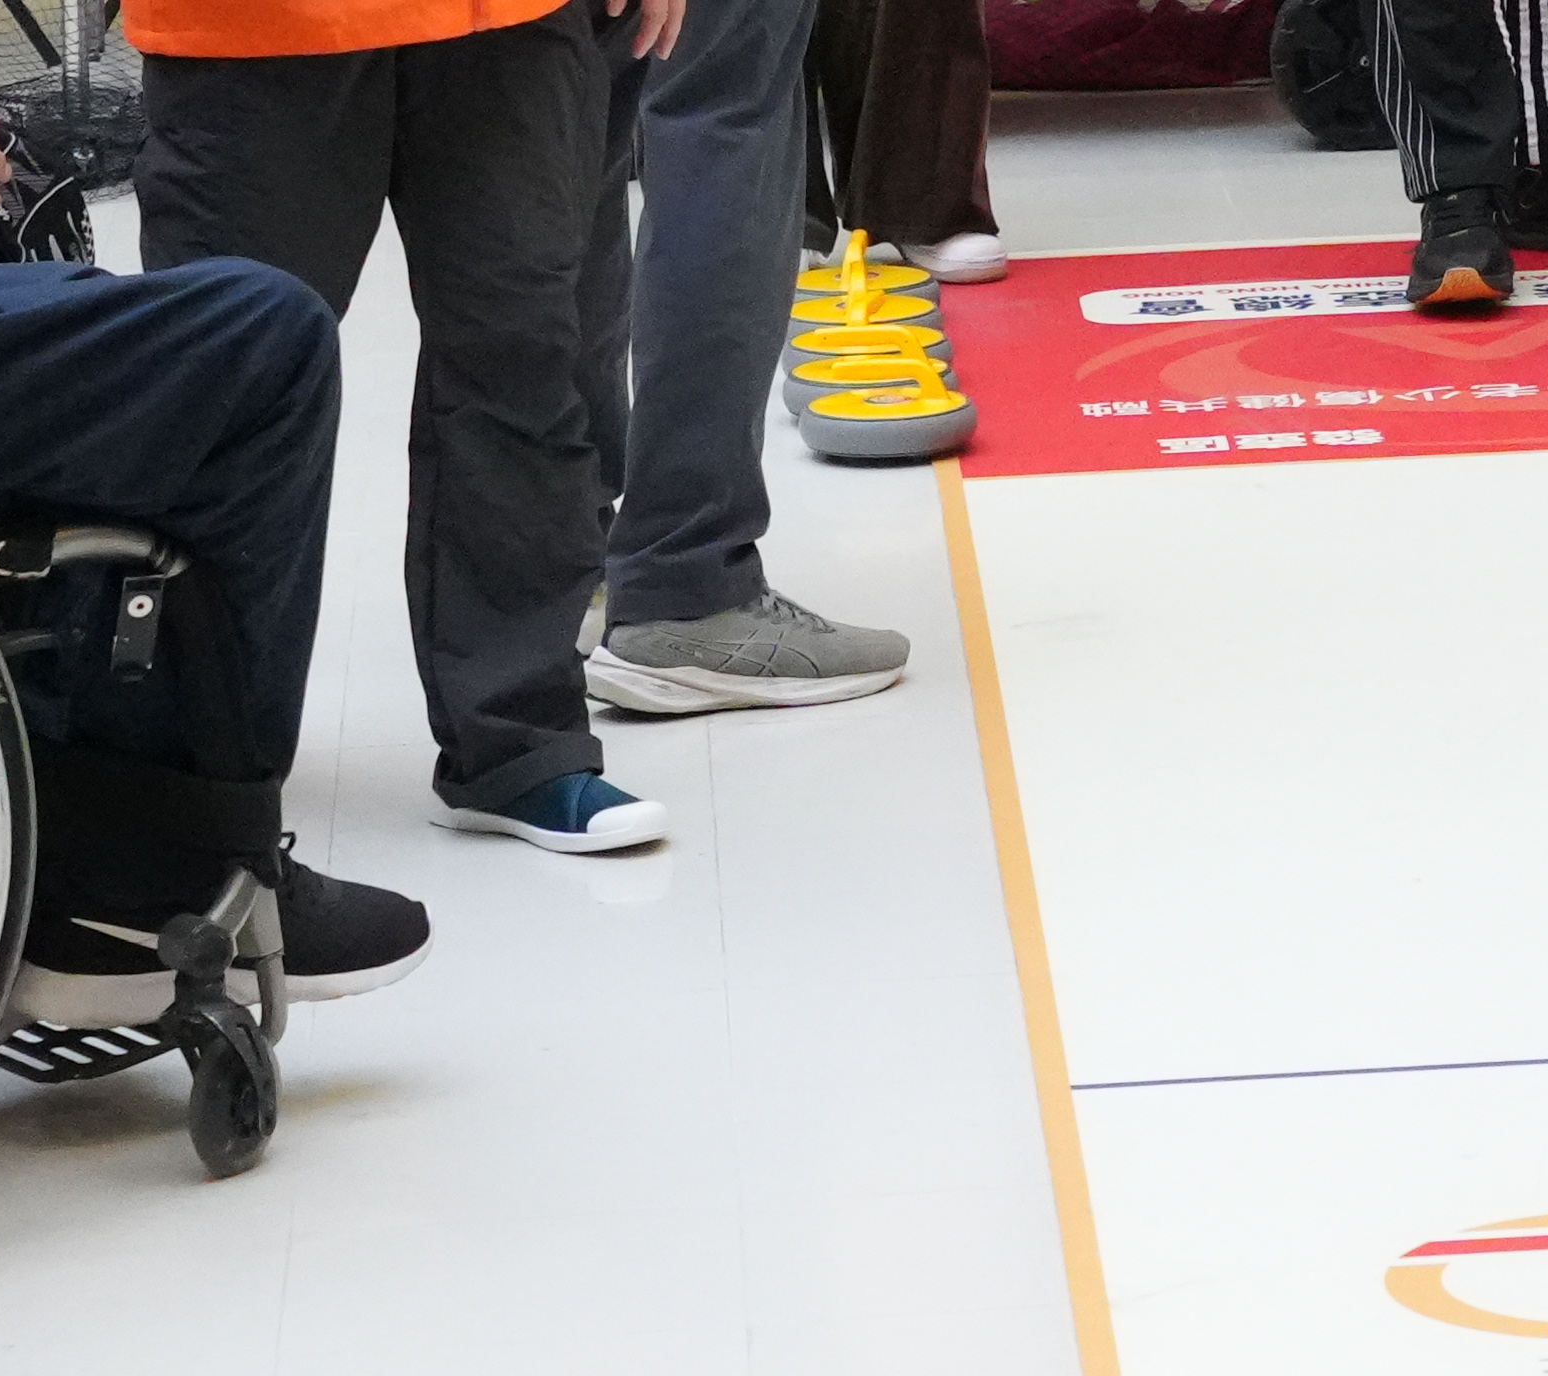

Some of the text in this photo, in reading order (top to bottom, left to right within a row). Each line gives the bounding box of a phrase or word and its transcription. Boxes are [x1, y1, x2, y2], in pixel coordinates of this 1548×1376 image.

[1216, 285, 1300, 295] HONG
[1310, 280, 1405, 290] CHINA
[1120, 290, 1205, 300] KONG
[1156, 428, 1385, 455] 發壺區
